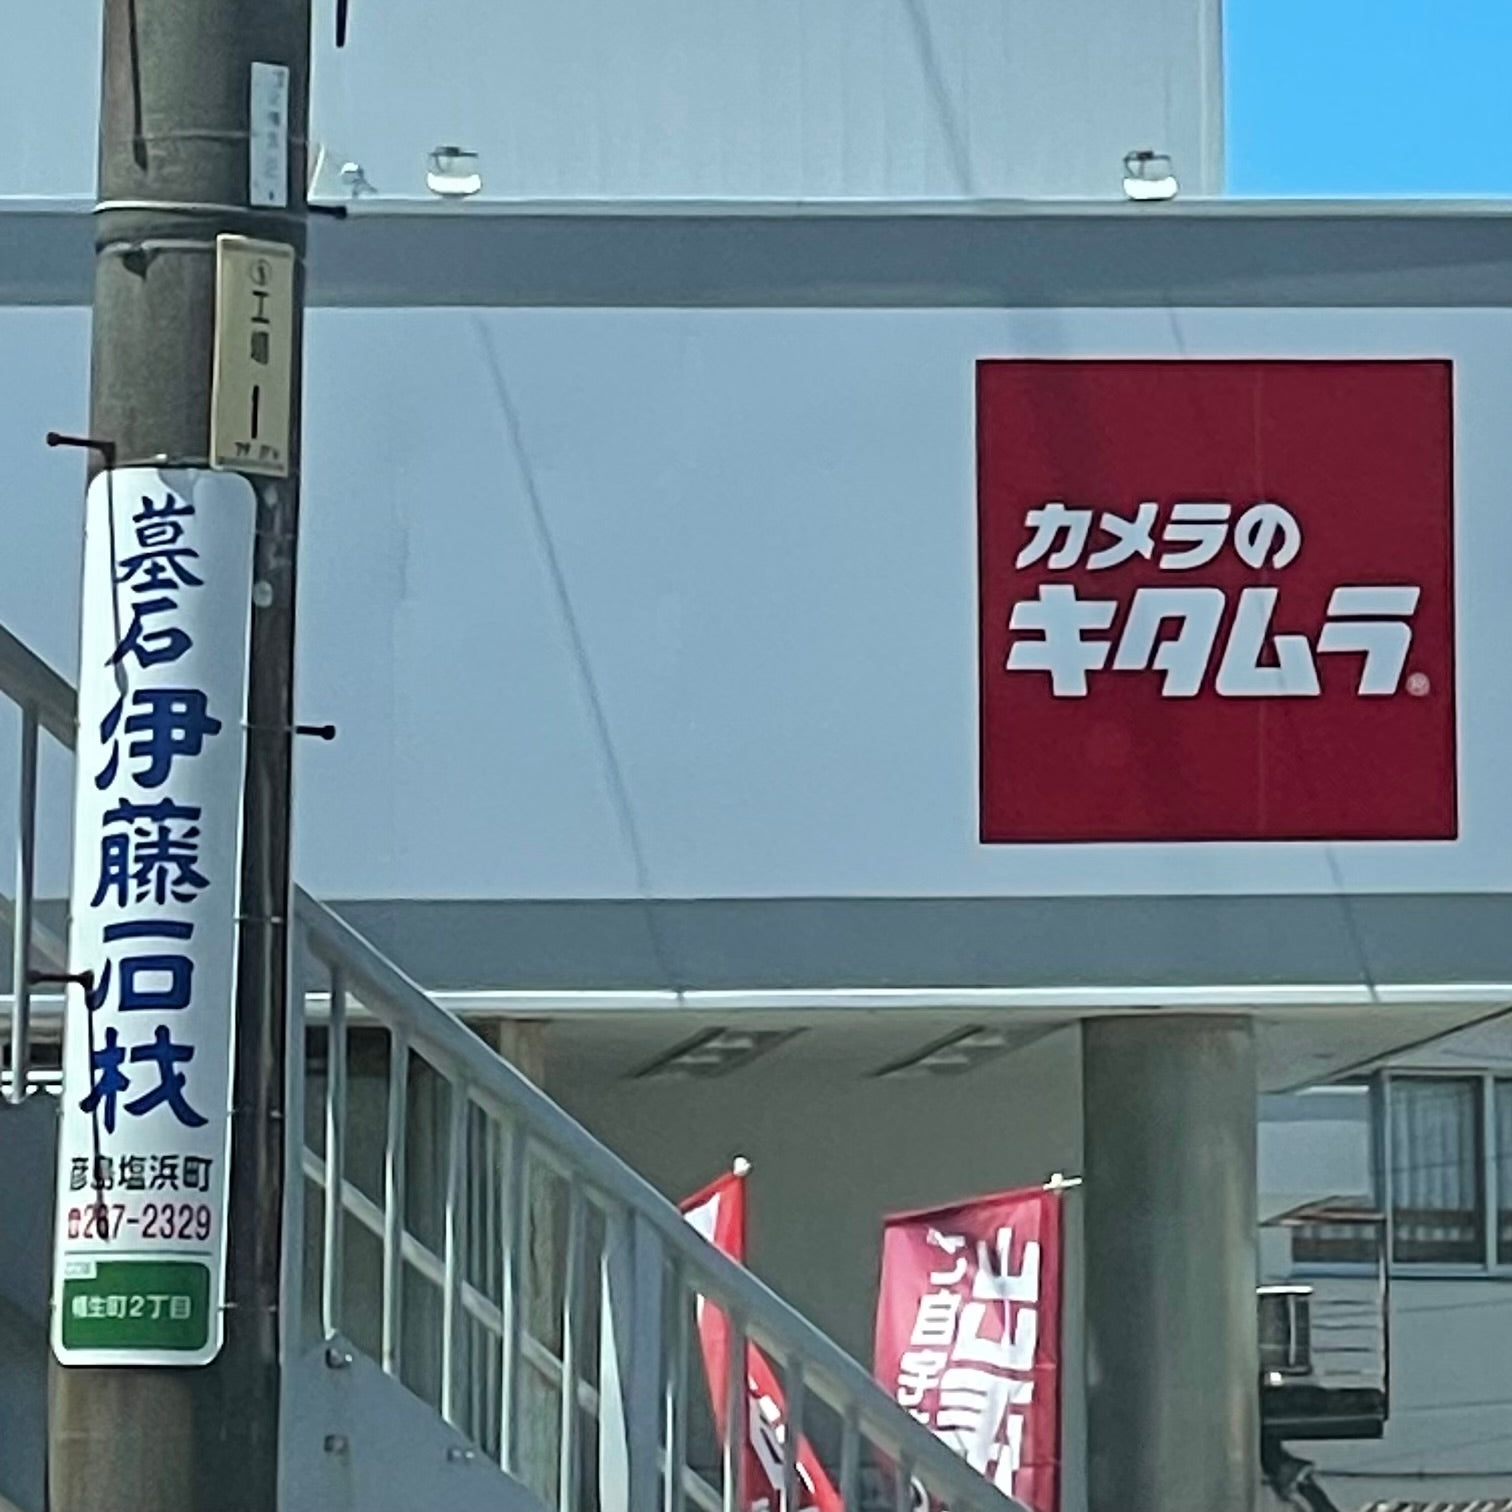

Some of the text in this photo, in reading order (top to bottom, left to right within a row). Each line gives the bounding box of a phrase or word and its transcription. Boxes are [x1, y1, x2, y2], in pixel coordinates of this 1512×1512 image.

[1016, 502, 1300, 570] カメラの
[1006, 584, 1420, 697] キタムラ
[69, 1154, 214, 1192] 彦島塩浜町
